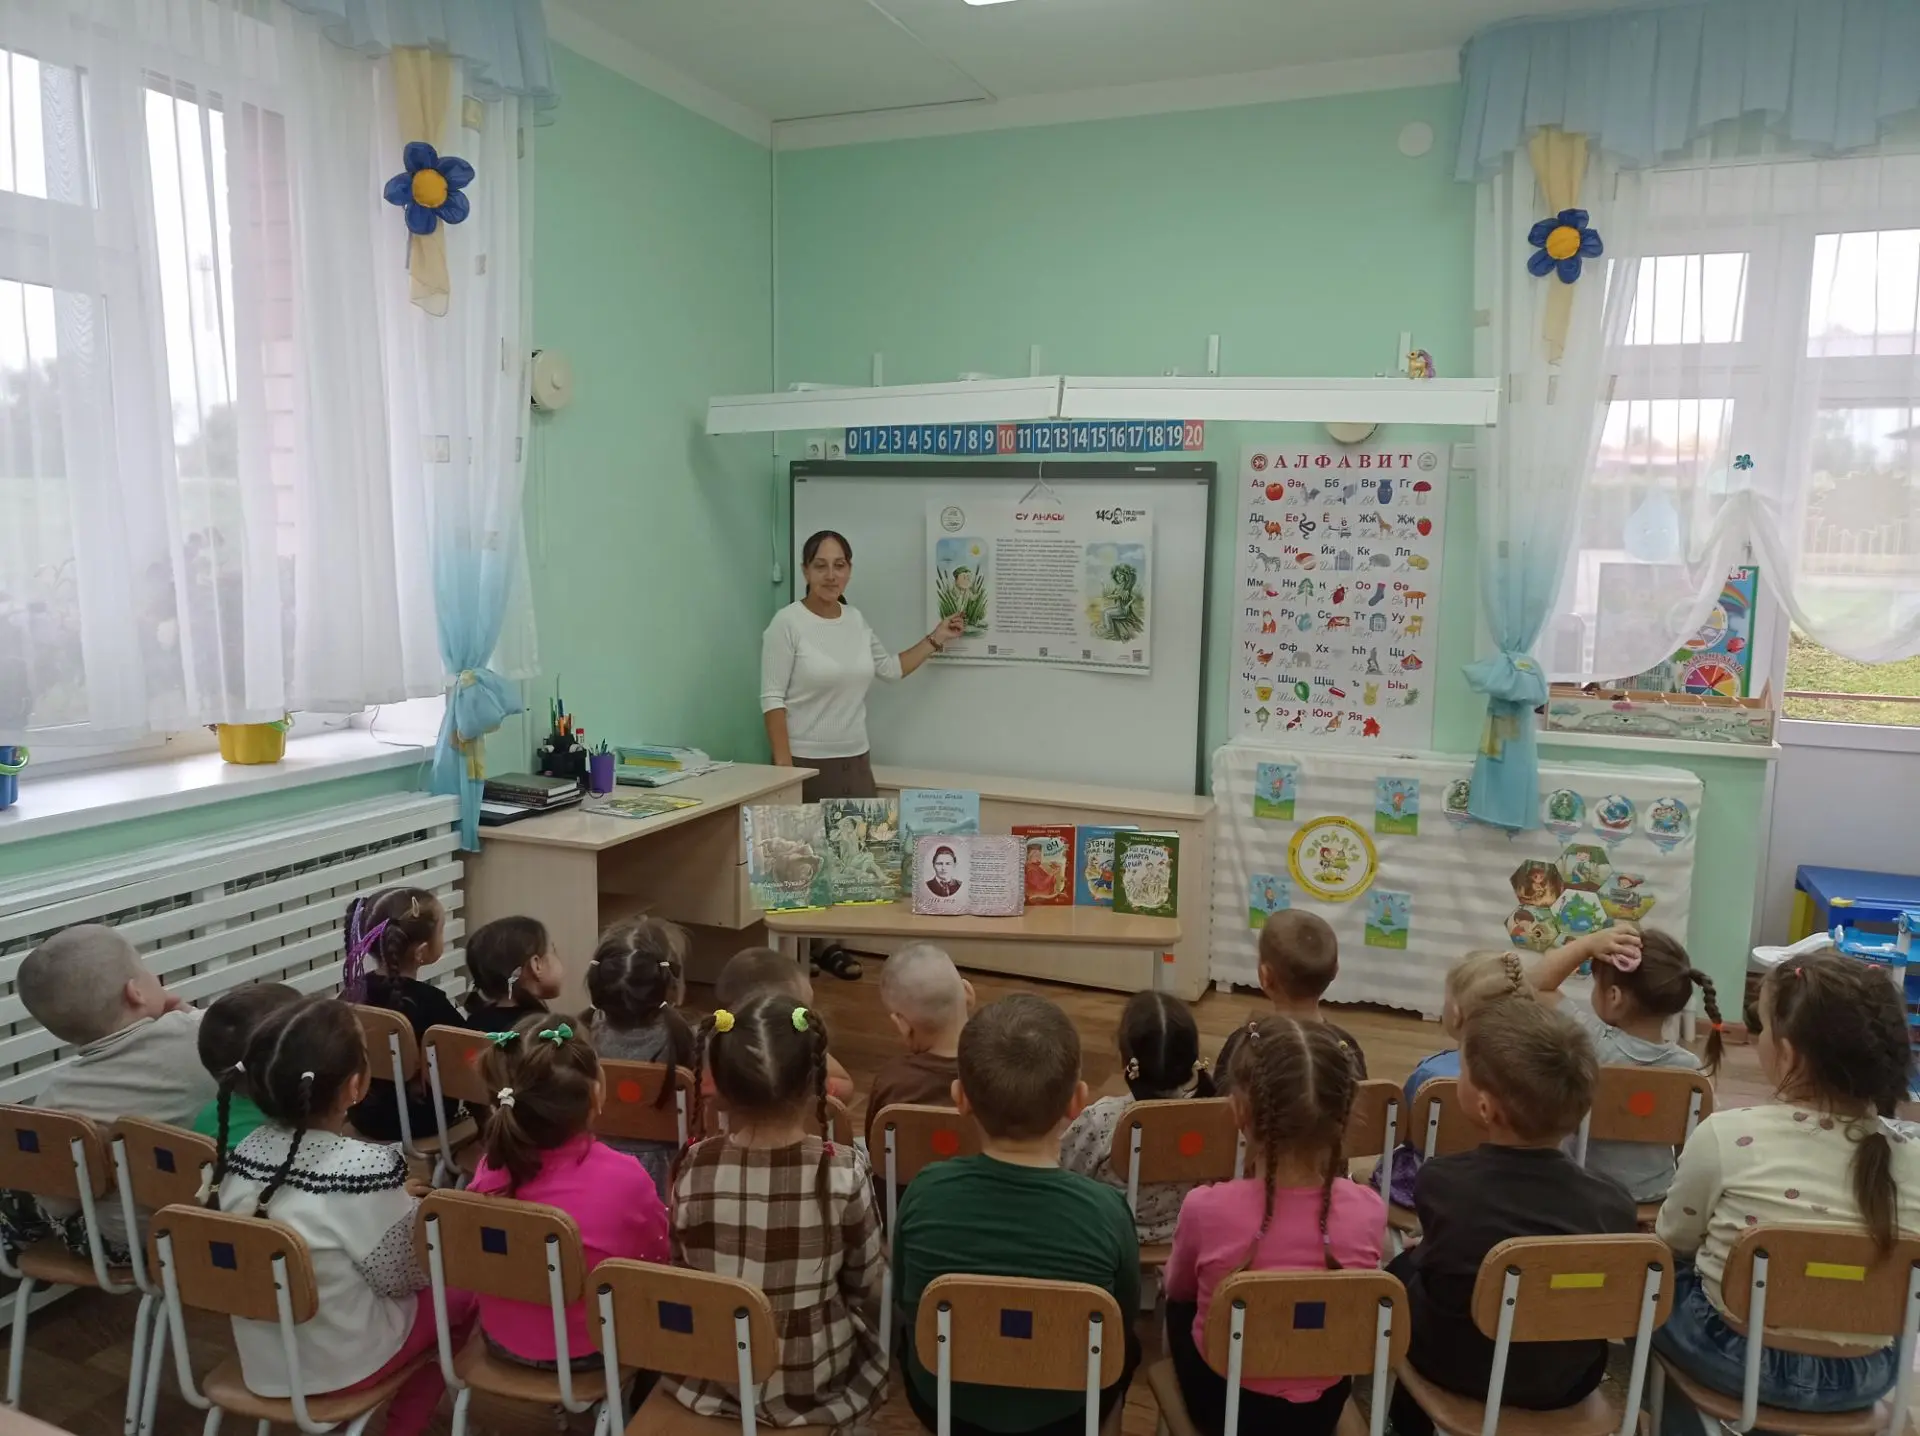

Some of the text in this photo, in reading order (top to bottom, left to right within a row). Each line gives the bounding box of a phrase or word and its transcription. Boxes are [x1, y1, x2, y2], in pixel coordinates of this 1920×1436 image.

[849, 426, 1202, 449] 0 1 2 3 4 5 6 7 8 9 10 11 12 13 14 15 16 17 18 19 20
[1274, 454, 1412, 468] АЛФАВИТ
[1252, 479, 1412, 488] Аа Әә Бб Вв Гг
[1032, 513, 1065, 521] АНАСЫ
[1249, 513, 1264, 523] Дд
[1285, 513, 1299, 522] Ее
[1359, 514, 1376, 523] Жж
[1249, 545, 1260, 553] Зз
[1284, 545, 1298, 554] Ии
[1321, 544, 1336, 554] Йй
[1357, 547, 1370, 555] Кк
[1247, 578, 1263, 586] Мм
[1282, 579, 1296, 587] Нн
[1355, 581, 1371, 590] Оо
[1246, 608, 1405, 624] Пп Рр Сс Тт Уу
[1279, 643, 1297, 653] Фф
[1316, 644, 1329, 653] Хх
[1390, 648, 1405, 657] Цц
[1243, 672, 1256, 681] Чч
[1278, 674, 1297, 683] Шш
[1388, 680, 1408, 689] Ыы
[1276, 708, 1289, 716] Ээ
[1313, 708, 1333, 718] Юю
[1348, 712, 1362, 721] Яя
